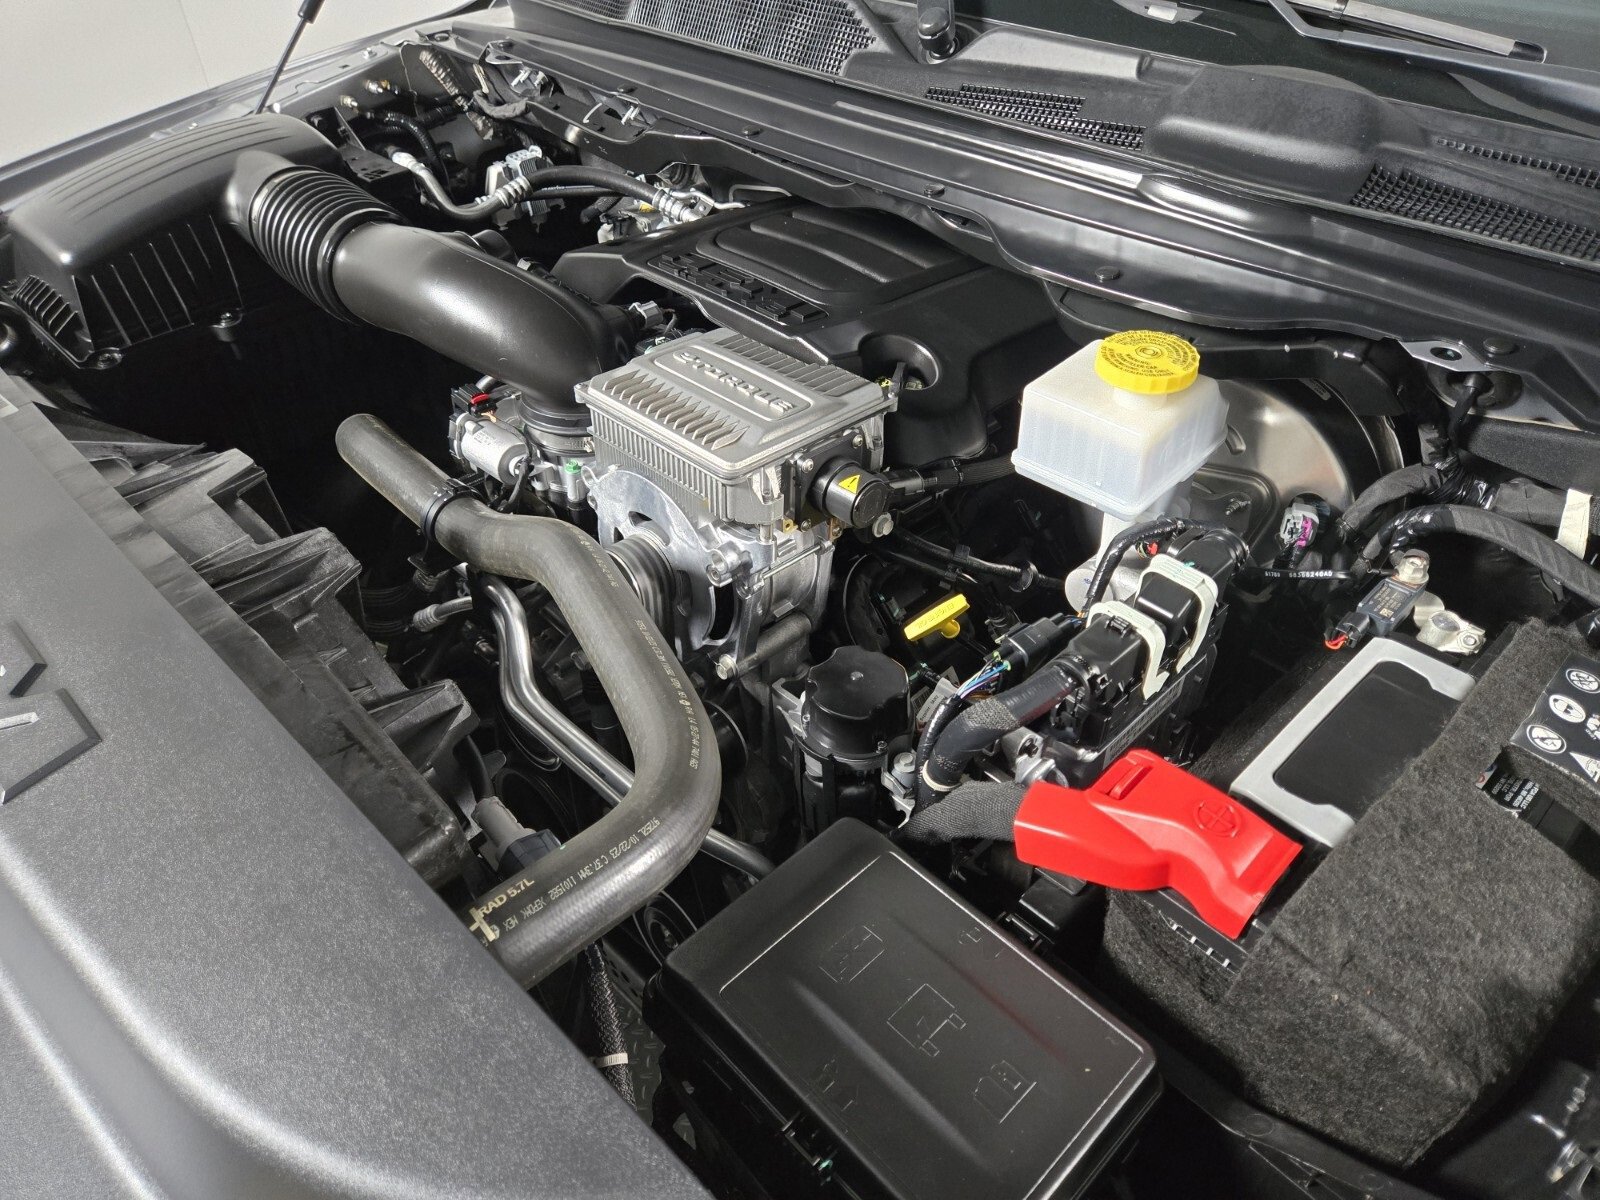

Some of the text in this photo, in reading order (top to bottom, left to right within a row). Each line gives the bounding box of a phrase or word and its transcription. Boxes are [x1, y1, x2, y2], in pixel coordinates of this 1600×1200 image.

[609, 834, 640, 859] 10/22/23
[478, 878, 535, 918] RAD 5.7L
